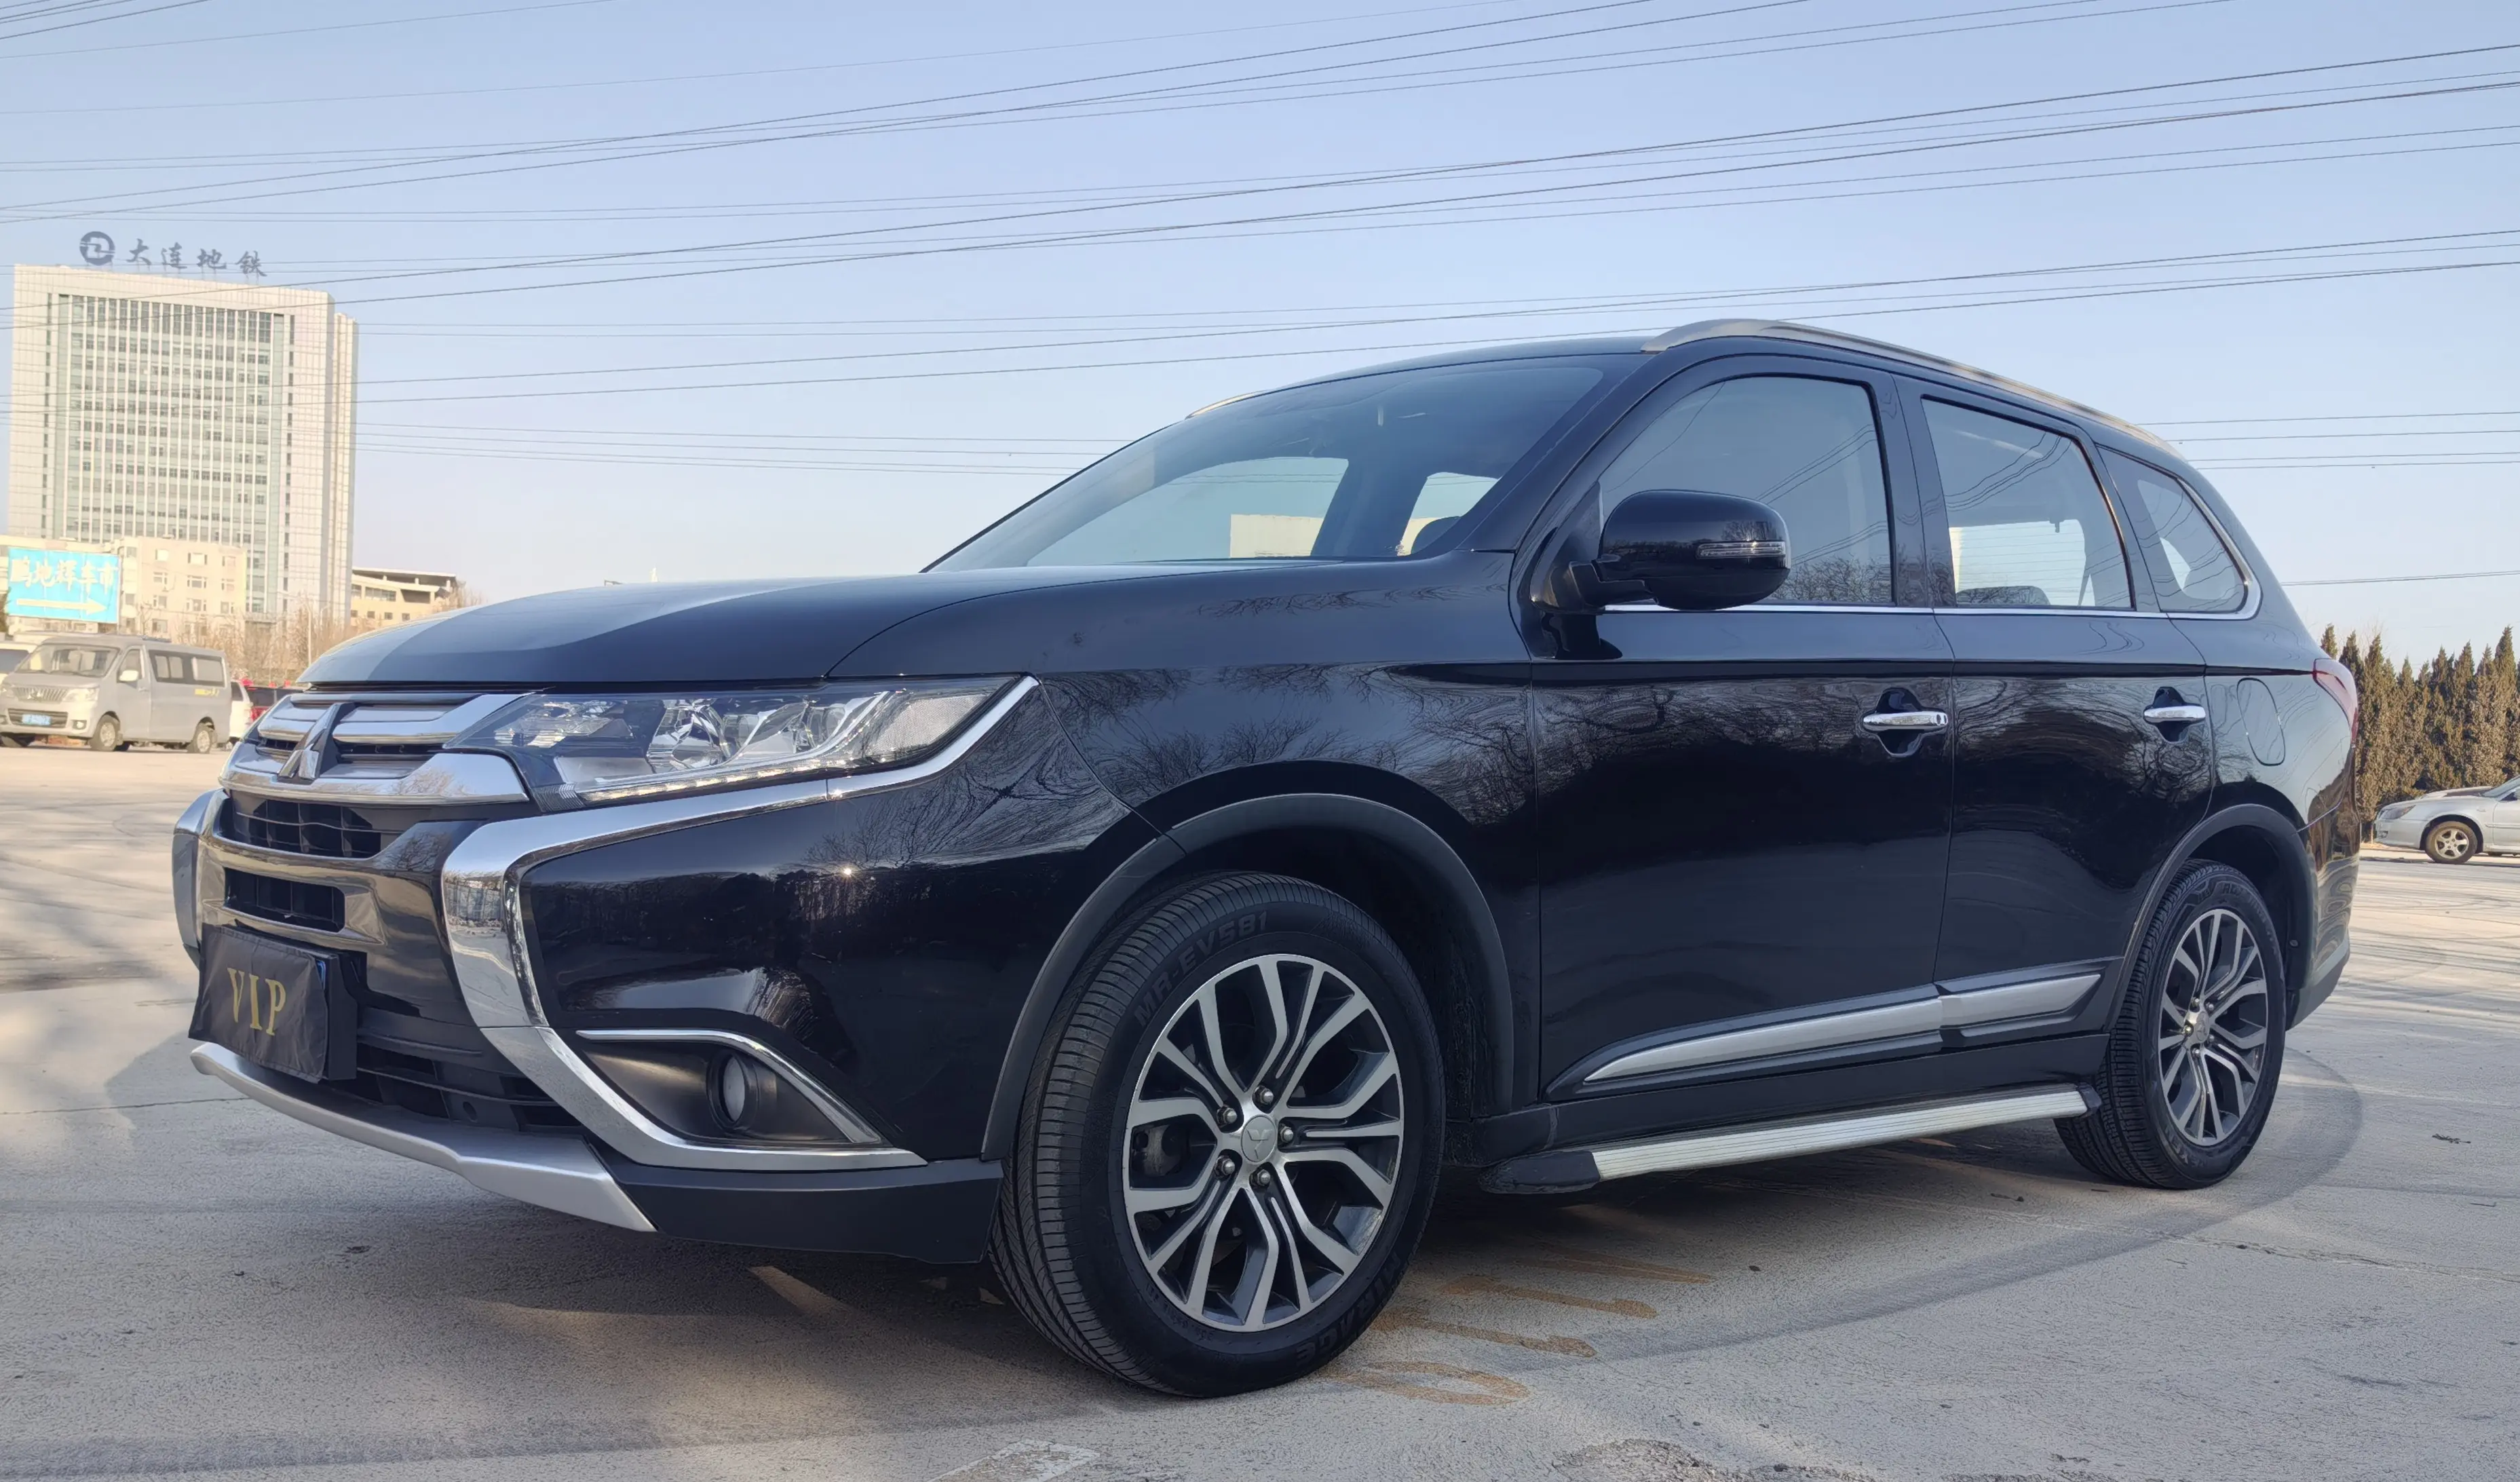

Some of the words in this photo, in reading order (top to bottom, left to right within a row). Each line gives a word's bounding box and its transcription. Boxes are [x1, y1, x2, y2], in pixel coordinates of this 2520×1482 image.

[127, 238, 267, 278] 大连地铁
[227, 967, 286, 1036] VIP
[1134, 910, 1268, 1027] MR-EV581
[1295, 1251, 1401, 1367] MIRAGE
